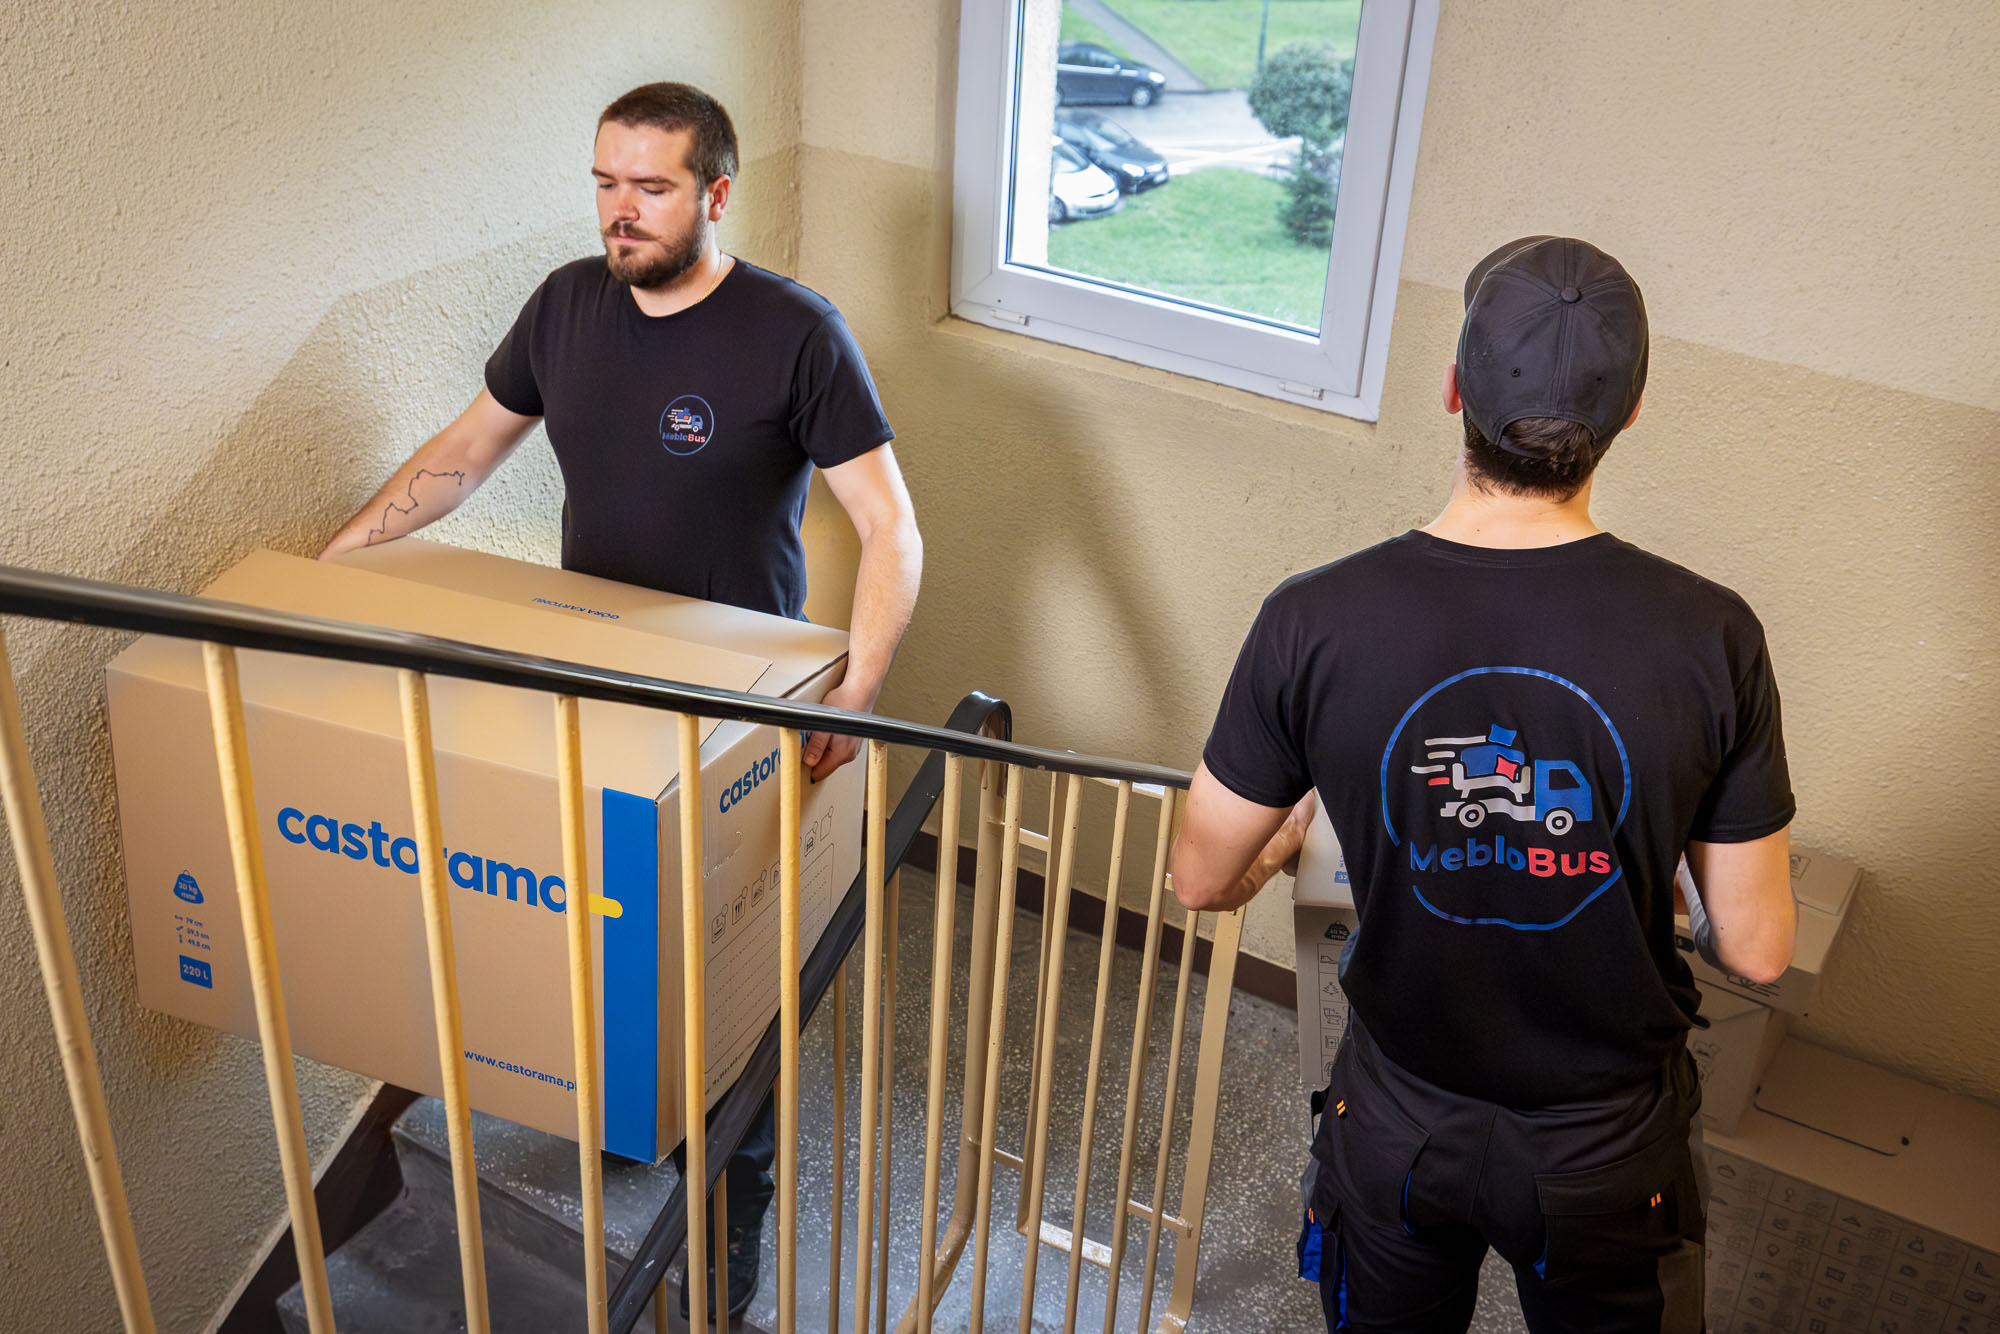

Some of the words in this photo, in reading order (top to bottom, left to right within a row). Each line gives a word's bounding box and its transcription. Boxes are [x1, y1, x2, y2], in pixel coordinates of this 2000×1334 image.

[662, 431, 706, 443] MebloBus
[277, 807, 566, 914] castoama
[1410, 834, 1611, 877] MebloBus
[183, 963, 201, 978] 220
[203, 970, 209, 980] L
